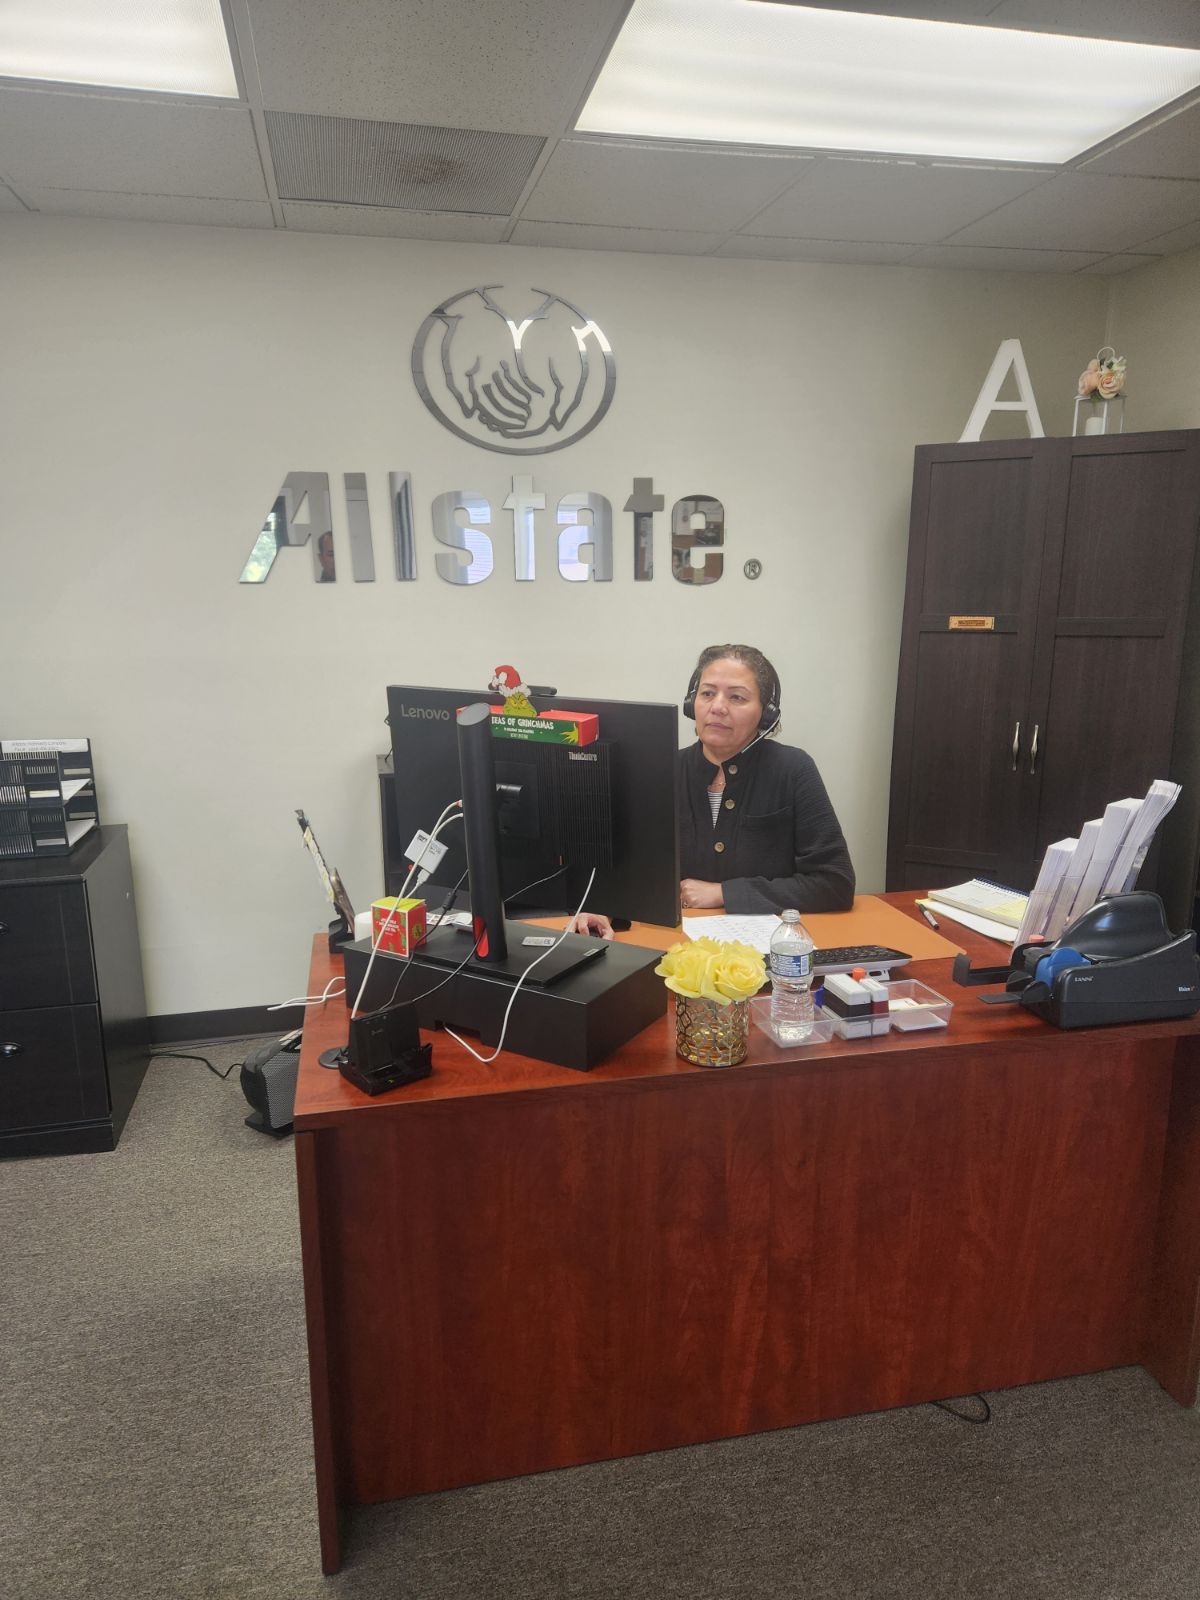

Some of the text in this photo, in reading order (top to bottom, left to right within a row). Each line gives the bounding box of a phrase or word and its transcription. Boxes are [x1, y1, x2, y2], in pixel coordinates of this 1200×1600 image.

[957, 338, 1046, 443] A
[238, 471, 726, 586] Allstate
[400, 703, 450, 721] Lenovo
[507, 717, 517, 727] OF
